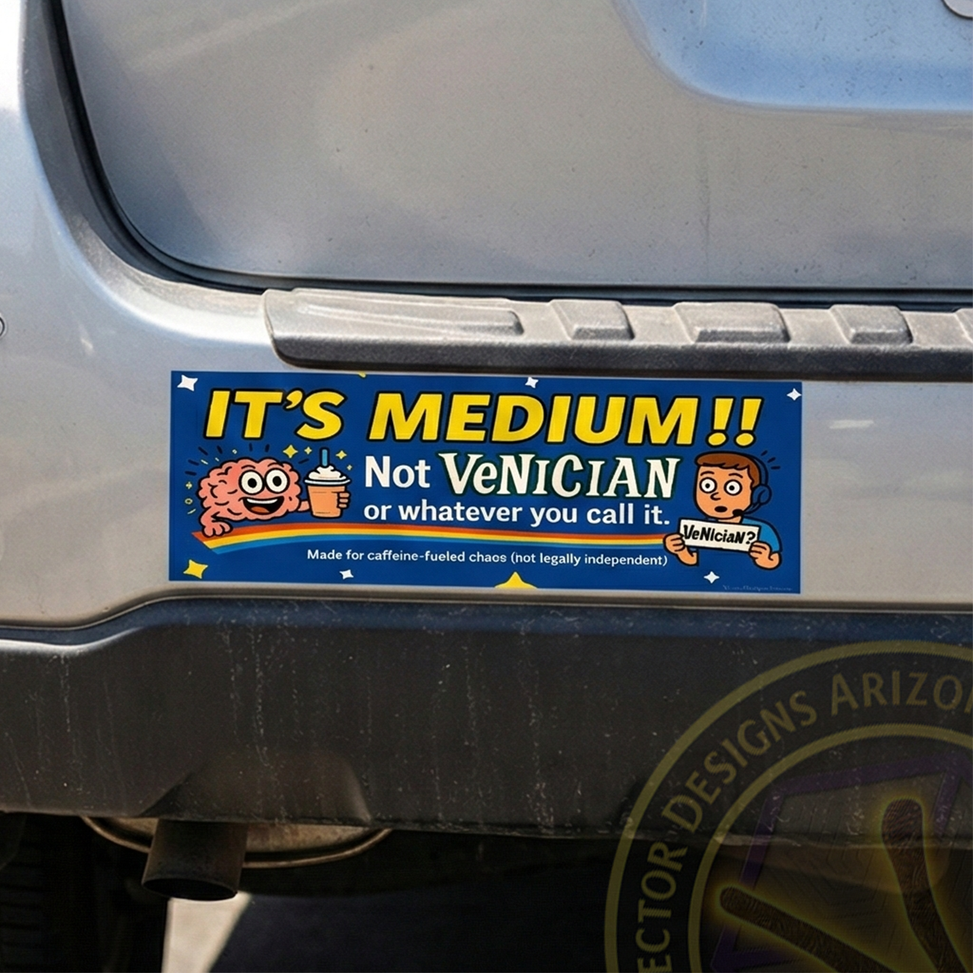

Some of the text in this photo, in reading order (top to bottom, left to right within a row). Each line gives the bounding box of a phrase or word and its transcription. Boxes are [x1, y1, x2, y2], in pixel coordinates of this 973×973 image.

[365, 456, 431, 488] Not
[363, 499, 671, 528] or whatever you call it.
[307, 549, 669, 568] Made for caffeine-fueled chaos (not legally independent)
